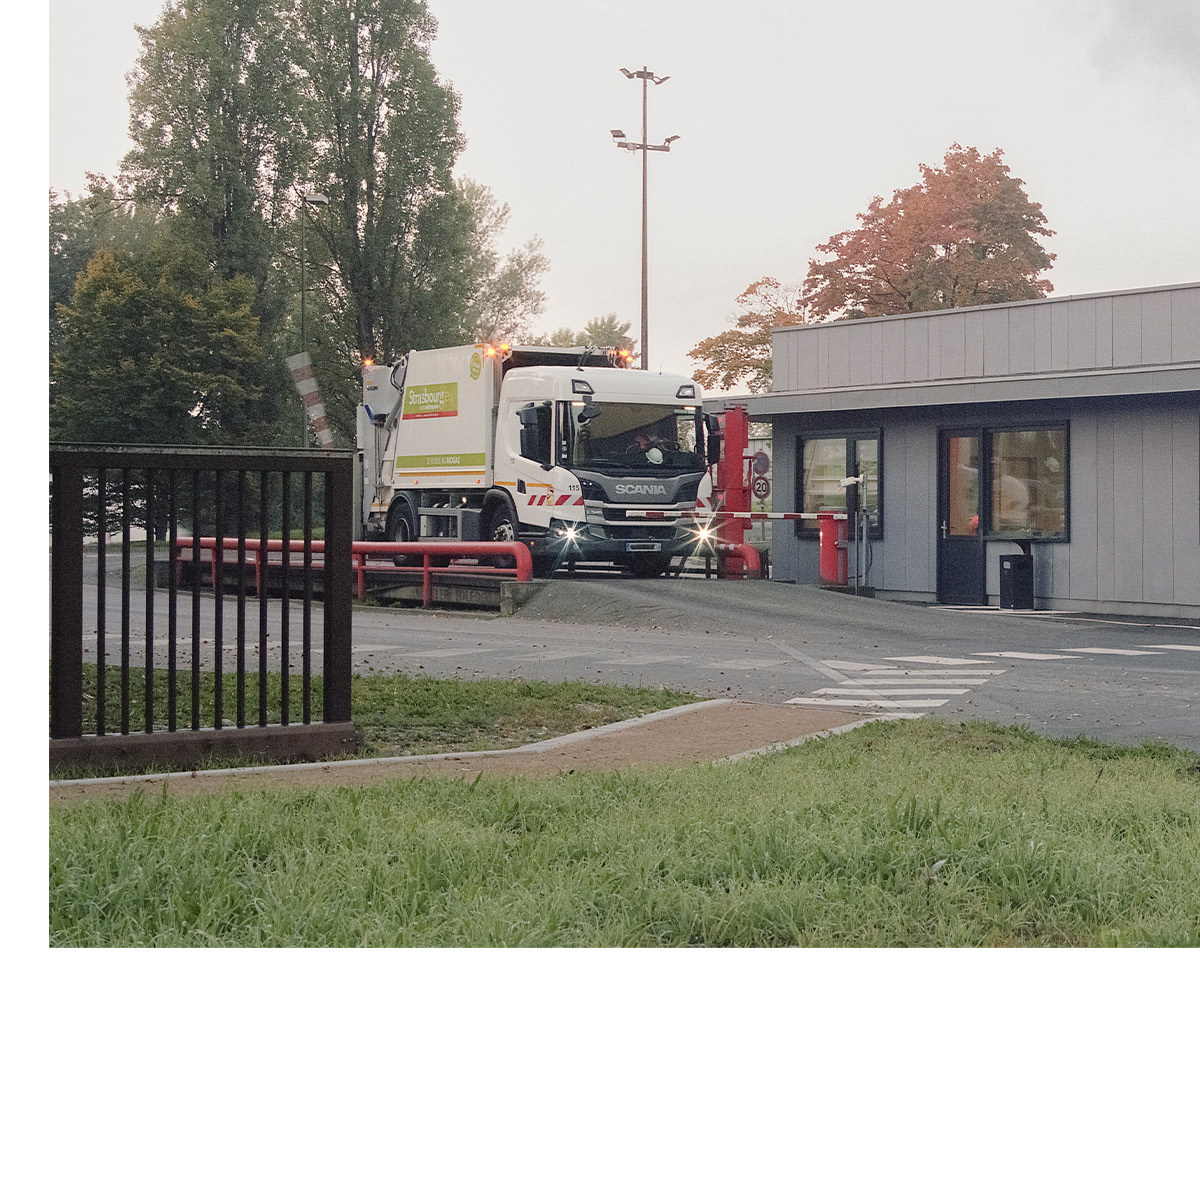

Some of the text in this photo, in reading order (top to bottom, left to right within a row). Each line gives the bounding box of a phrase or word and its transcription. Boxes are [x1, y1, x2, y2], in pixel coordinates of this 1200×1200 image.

[568, 484, 580, 492] 115
[615, 484, 667, 495] SCANIA
[756, 482, 767, 493] 20
